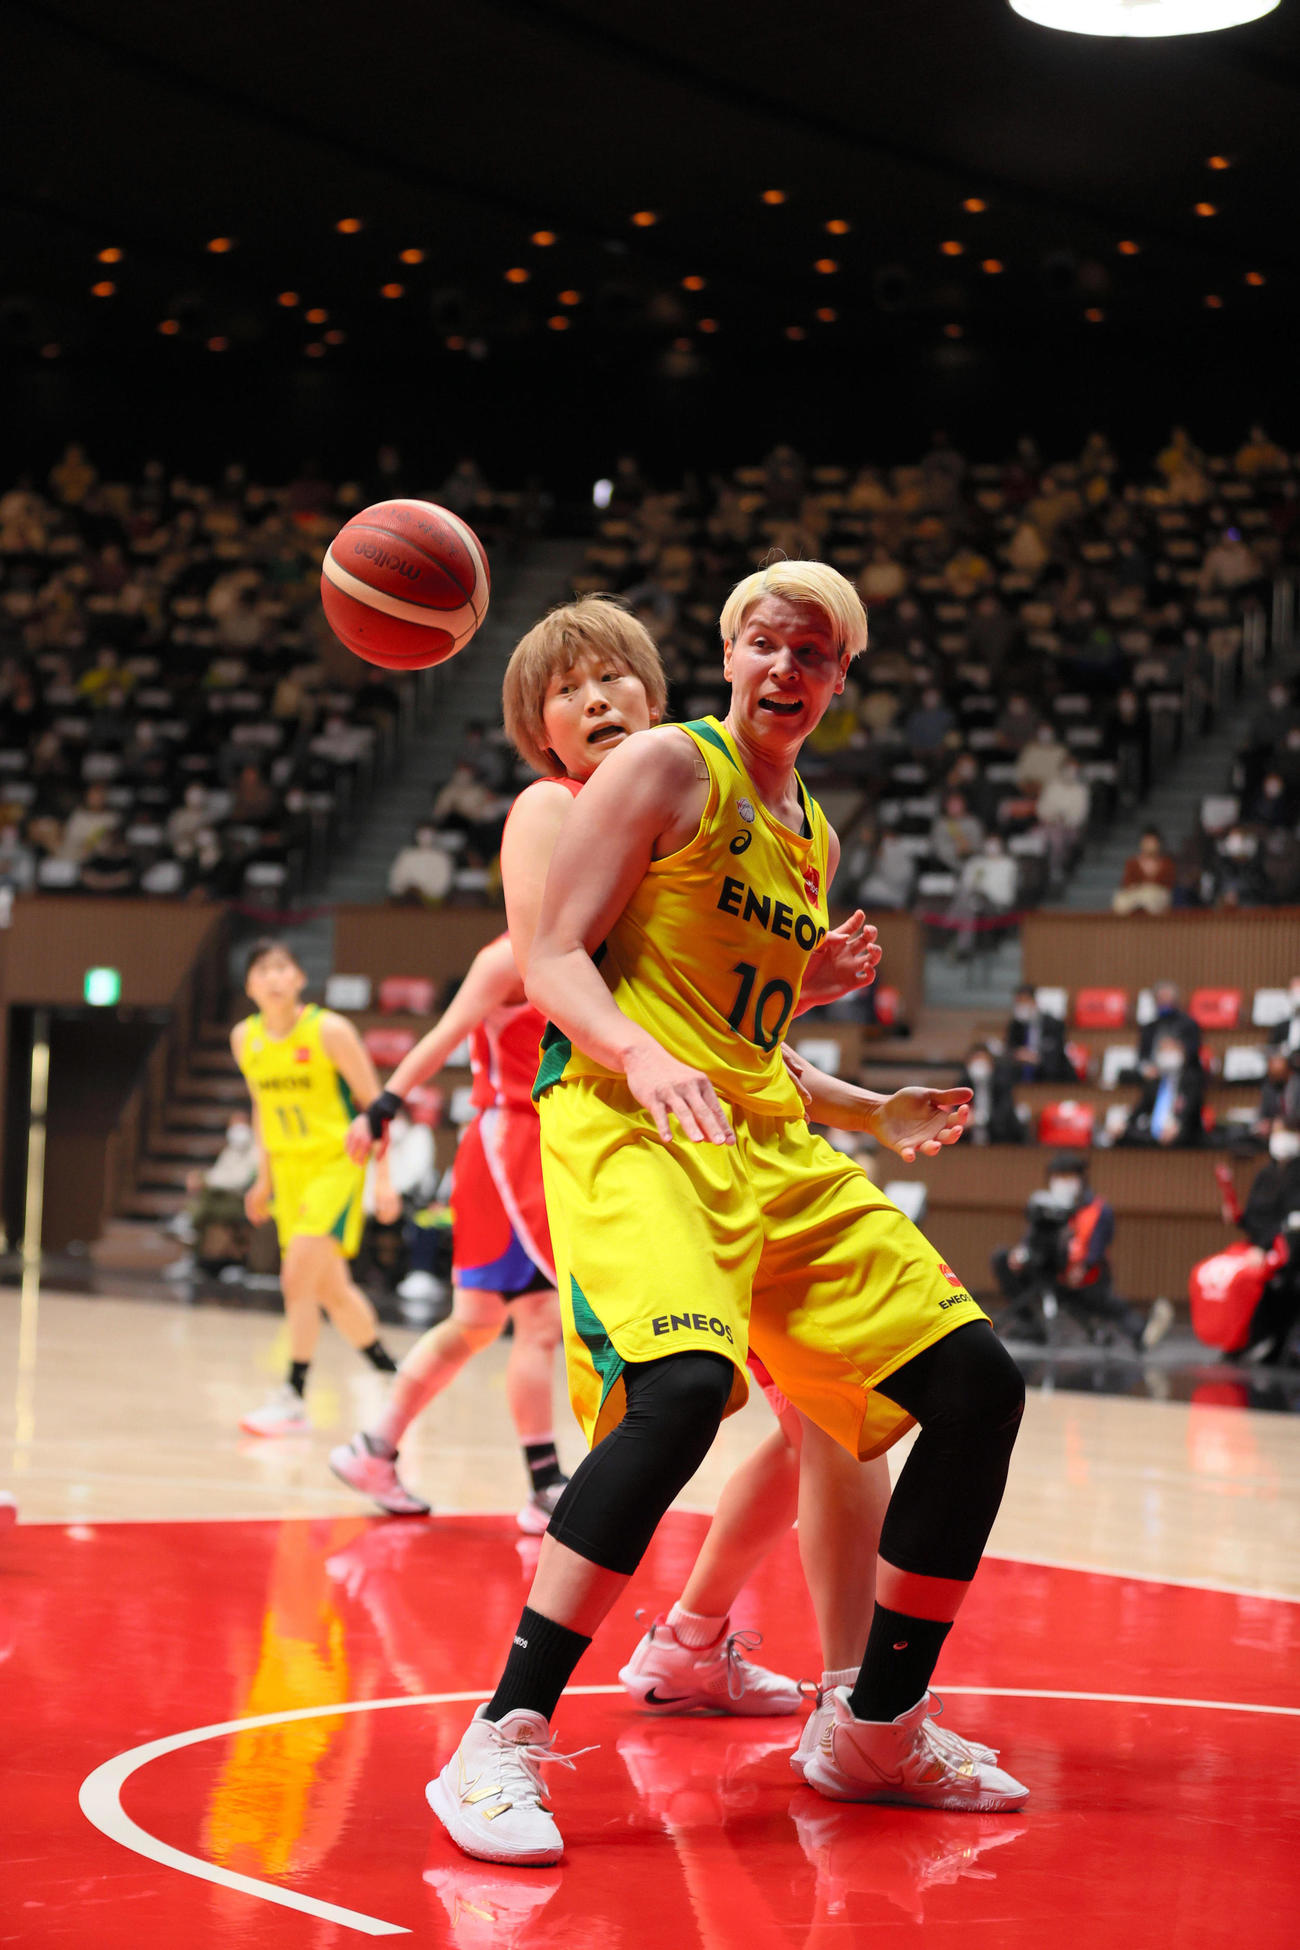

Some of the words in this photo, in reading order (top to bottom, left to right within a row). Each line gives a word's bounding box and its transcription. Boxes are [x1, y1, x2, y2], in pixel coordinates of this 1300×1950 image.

[354, 542, 421, 581] molten
[729, 961, 794, 1053] 10
[275, 1105, 307, 1138] 11
[652, 1313, 734, 1345] ENEOS
